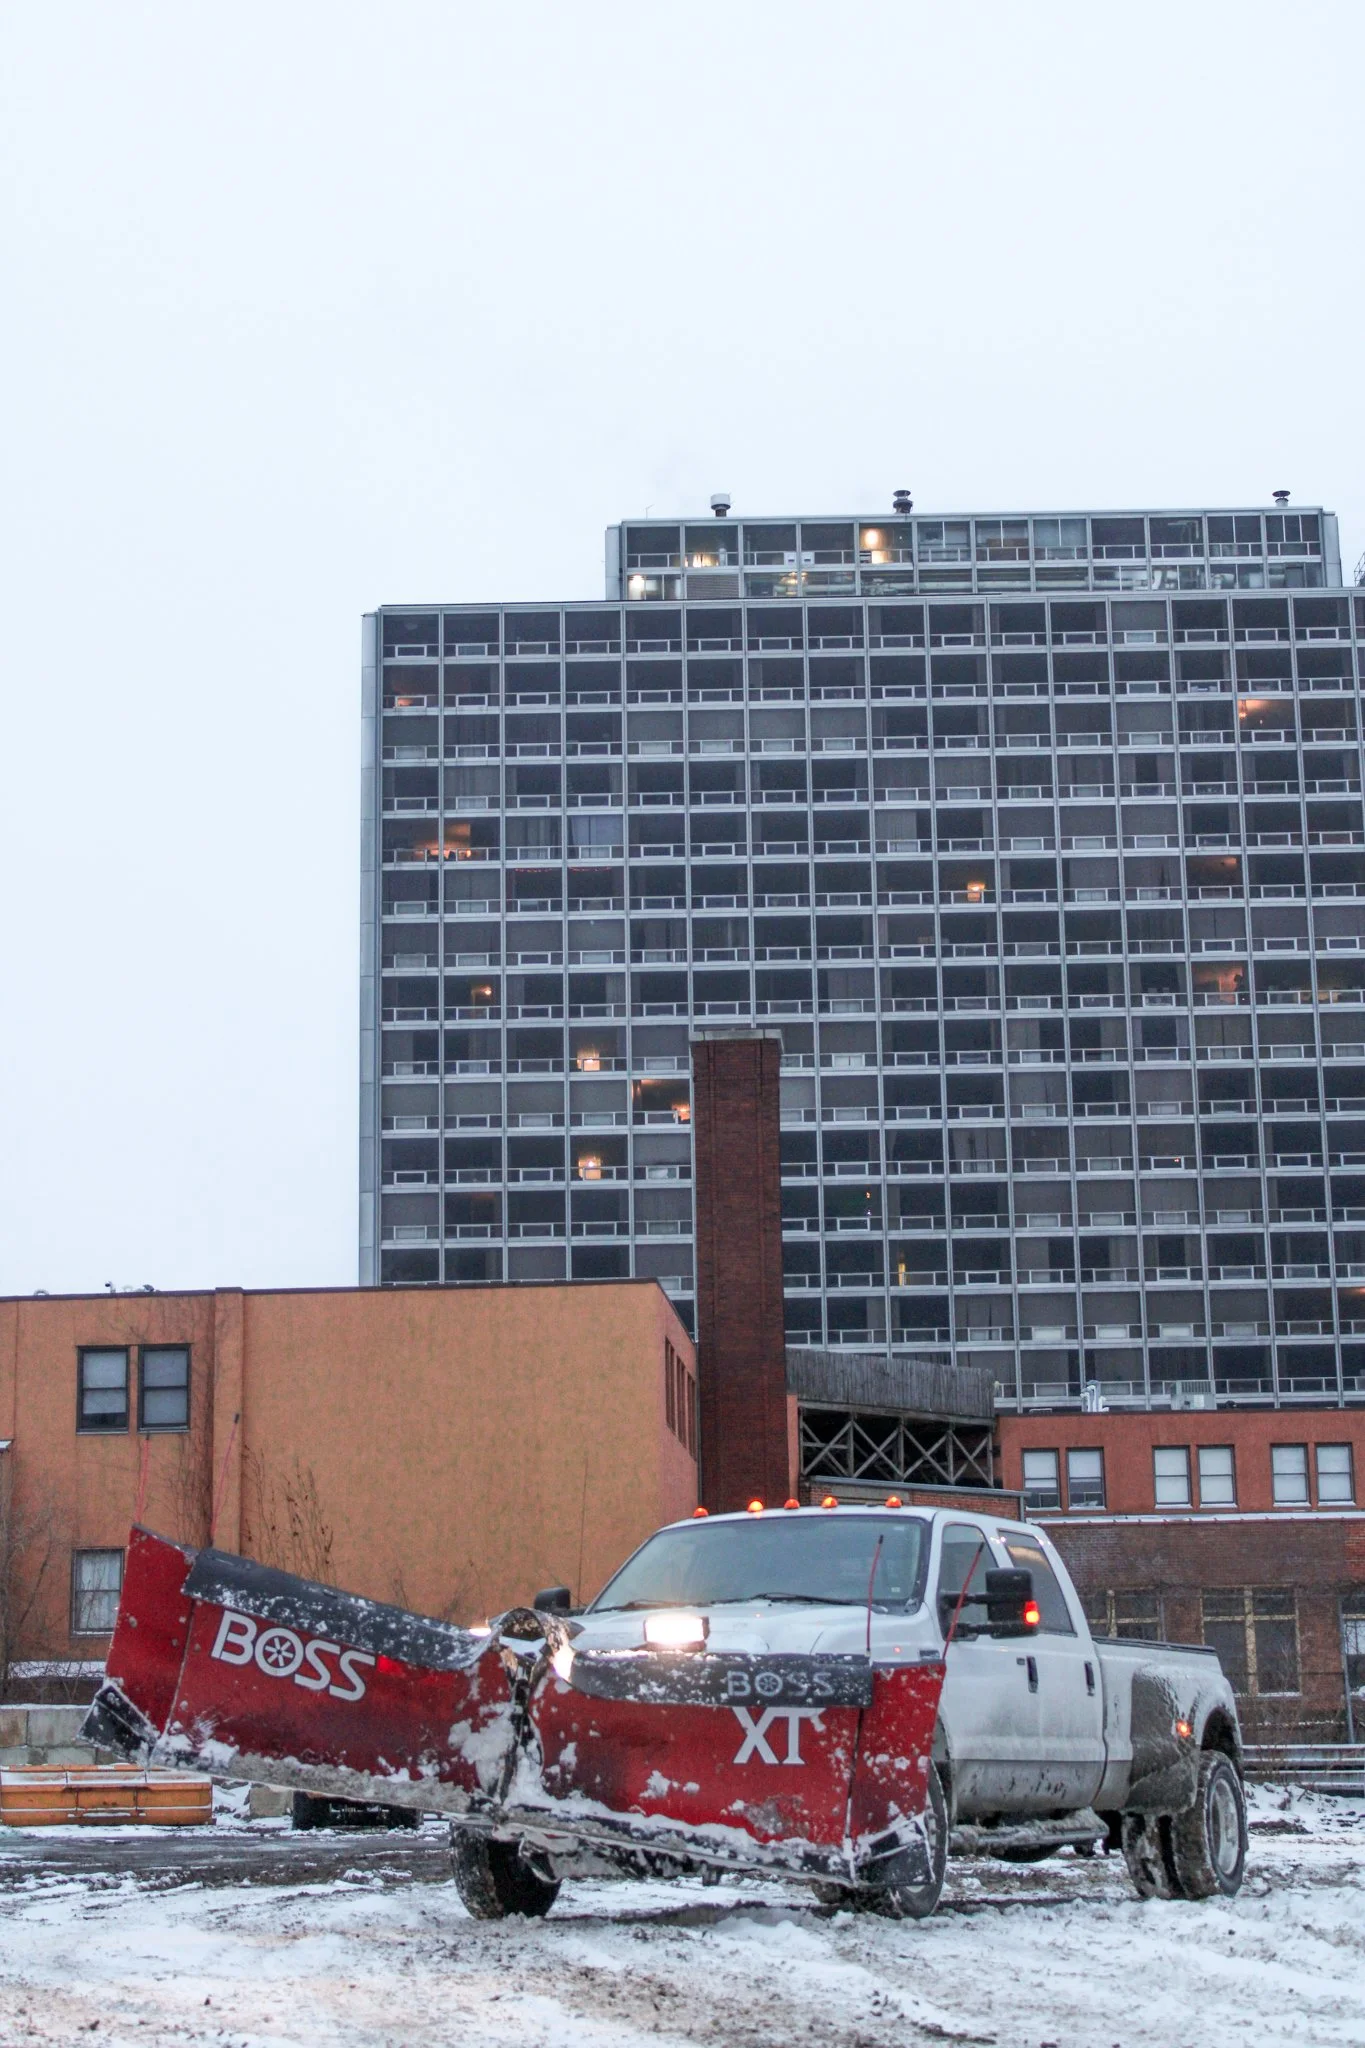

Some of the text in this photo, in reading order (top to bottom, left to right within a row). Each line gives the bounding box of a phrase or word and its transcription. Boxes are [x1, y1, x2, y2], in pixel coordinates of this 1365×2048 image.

[211, 1609, 376, 1701] BOSS
[726, 1670, 835, 1697] BOSS
[731, 1706, 827, 1765] XT
